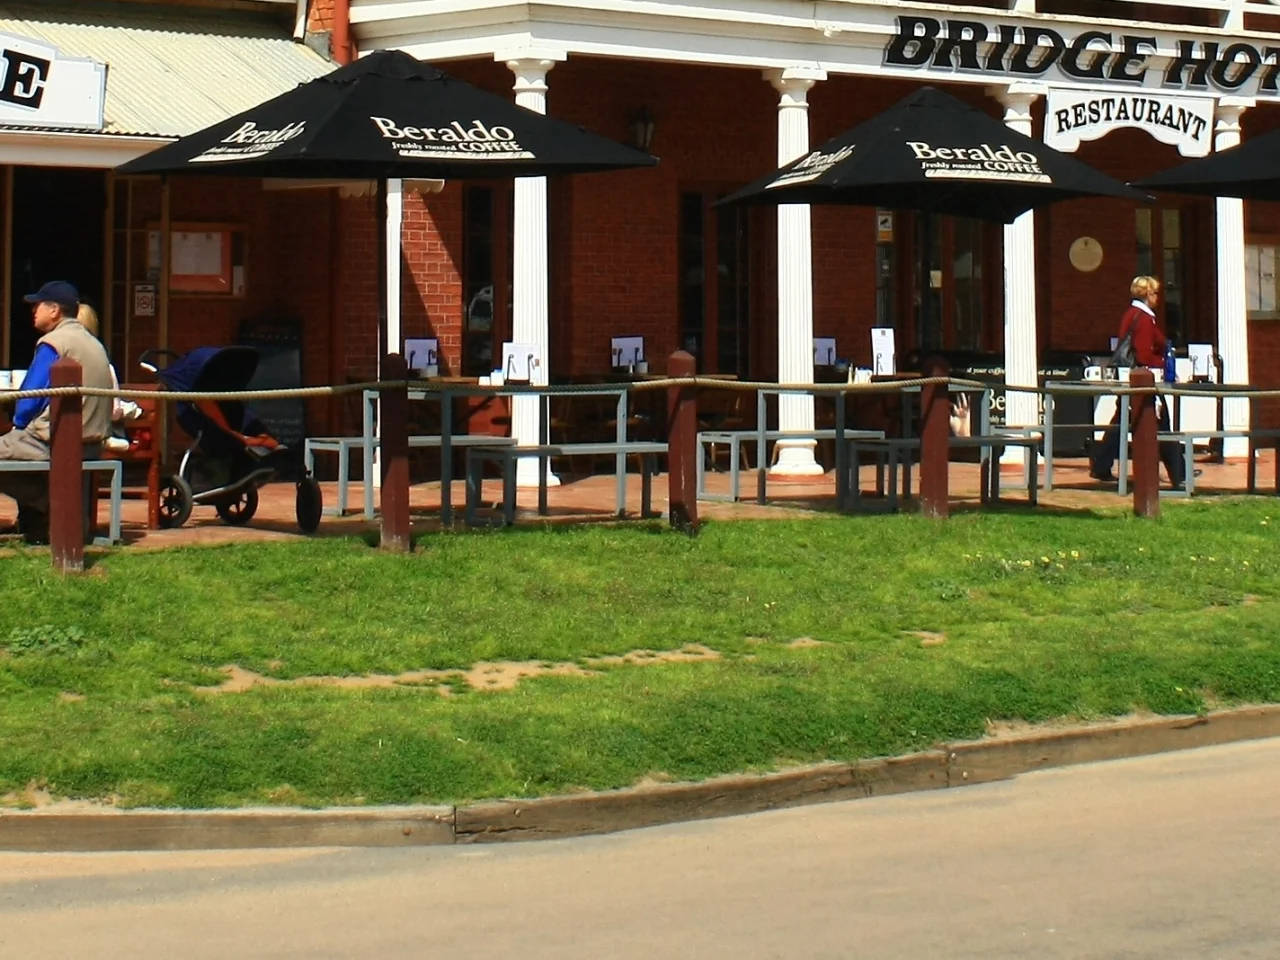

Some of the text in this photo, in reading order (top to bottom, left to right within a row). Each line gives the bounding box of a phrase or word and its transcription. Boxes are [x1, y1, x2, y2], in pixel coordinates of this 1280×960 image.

[884, 15, 1157, 84] BRIDGE
[370, 116, 515, 142] Beraldo
[1054, 97, 1207, 141] RESTAURANT
[221, 121, 307, 143] Beraldo
[458, 140, 523, 152] COFFEE
[905, 141, 1038, 164] Beraldo
[983, 161, 1043, 174] COFFEE
